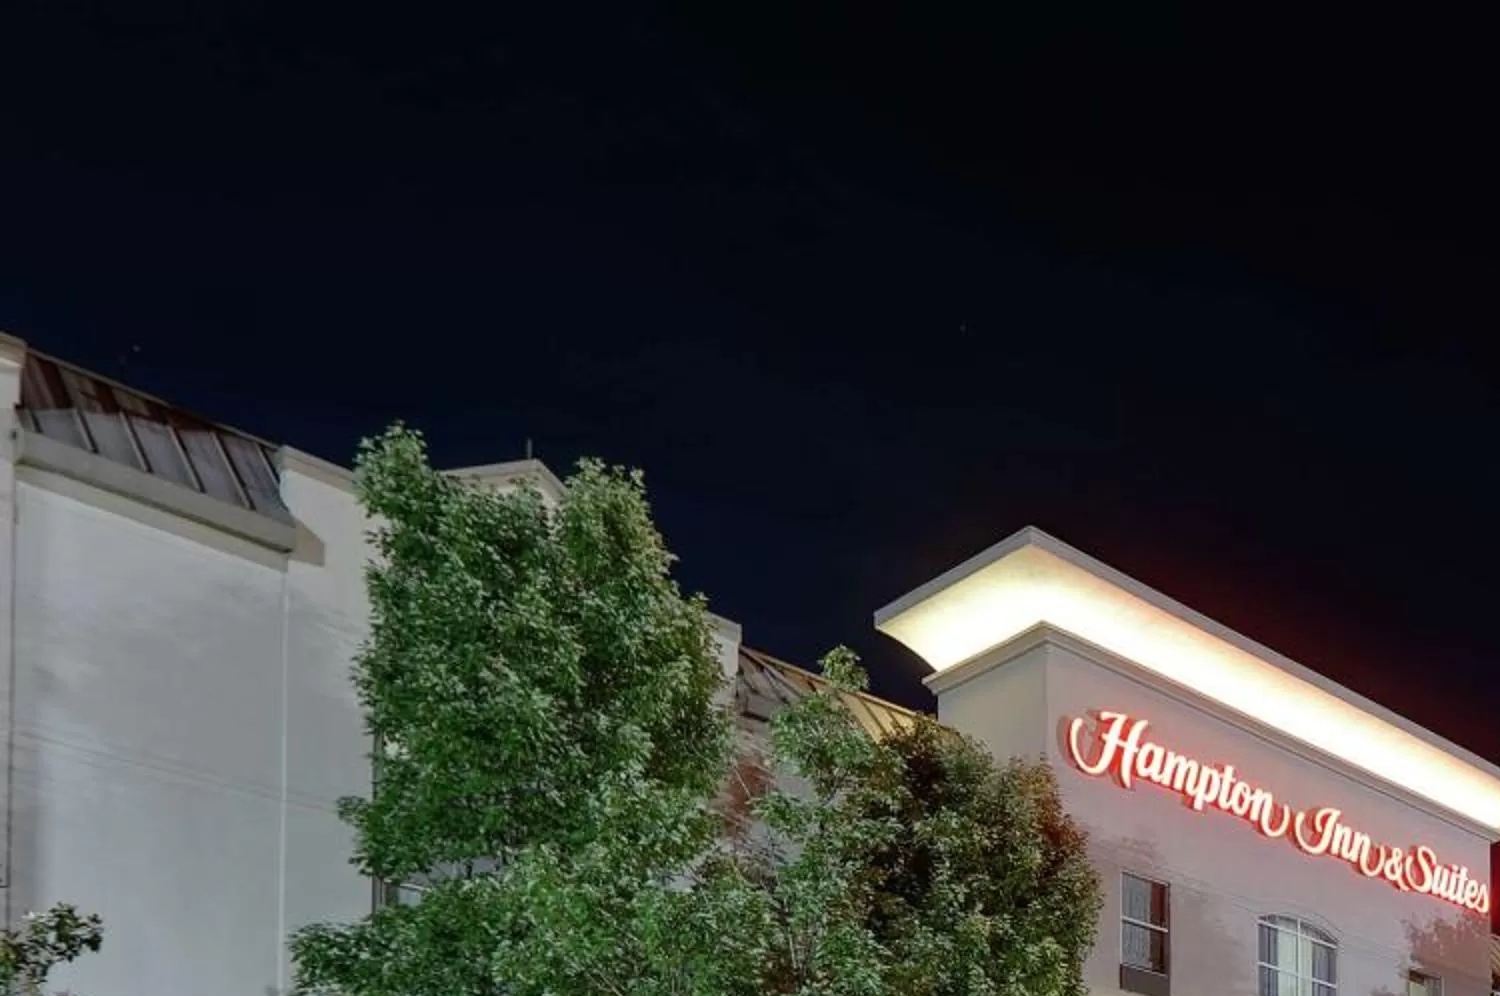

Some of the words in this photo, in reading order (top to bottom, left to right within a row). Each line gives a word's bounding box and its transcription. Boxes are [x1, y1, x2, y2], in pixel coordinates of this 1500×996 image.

[1069, 711, 1290, 838] Hampton
[1294, 807, 1386, 877] Inn
[1405, 845, 1489, 914] Suites
